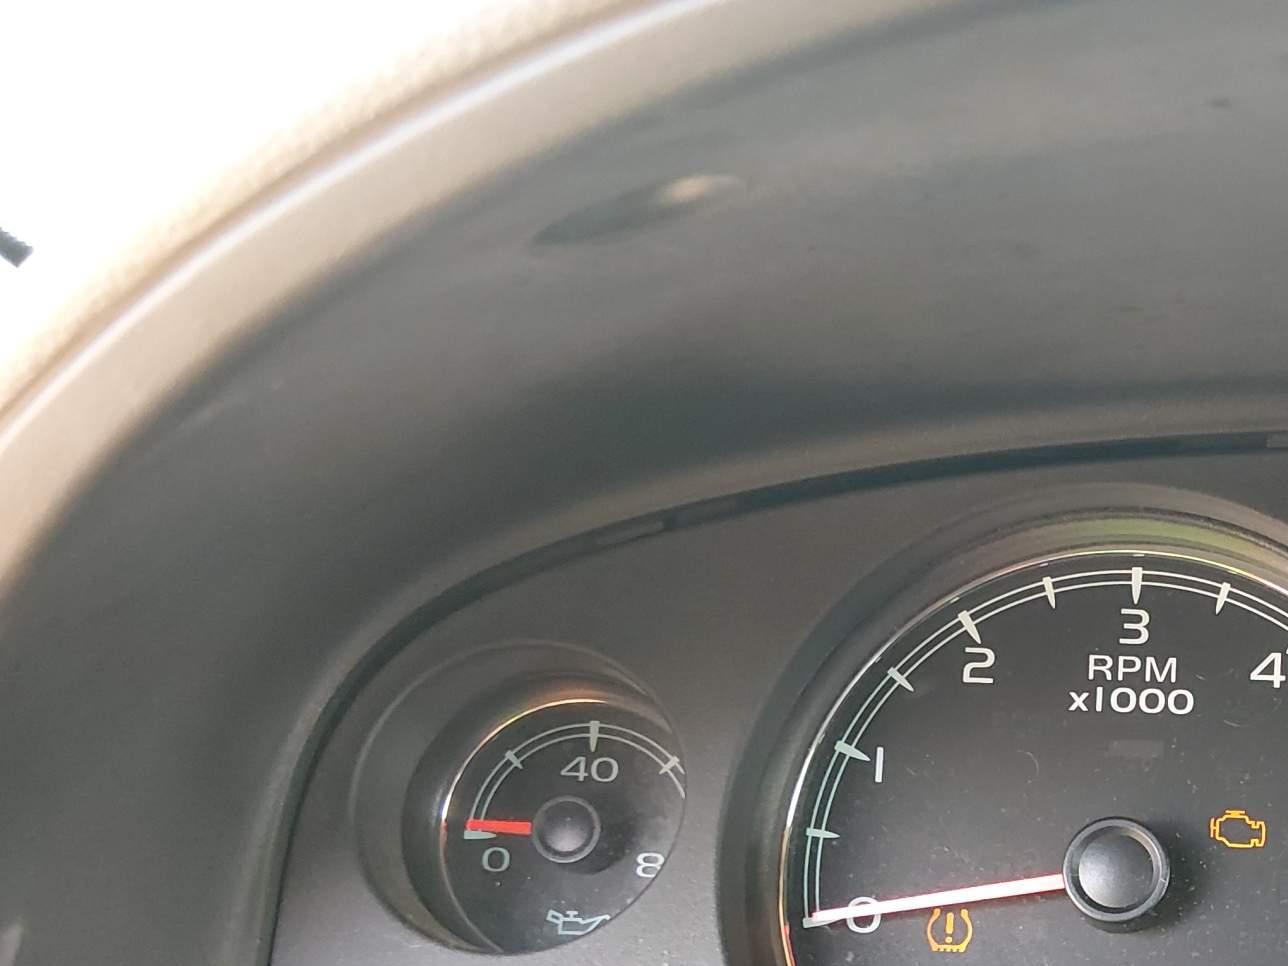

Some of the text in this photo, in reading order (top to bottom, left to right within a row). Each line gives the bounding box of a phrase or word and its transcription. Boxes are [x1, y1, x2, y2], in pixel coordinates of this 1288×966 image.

[1120, 610, 1150, 645] 3
[963, 648, 995, 684] 2
[1088, 656, 1178, 681] RPM
[1250, 654, 1287, 689] 4
[1068, 688, 1195, 715] x1000
[560, 756, 619, 782] 40
[874, 746, 885, 783] 1
[481, 847, 510, 872] 0
[847, 896, 881, 933] 0
